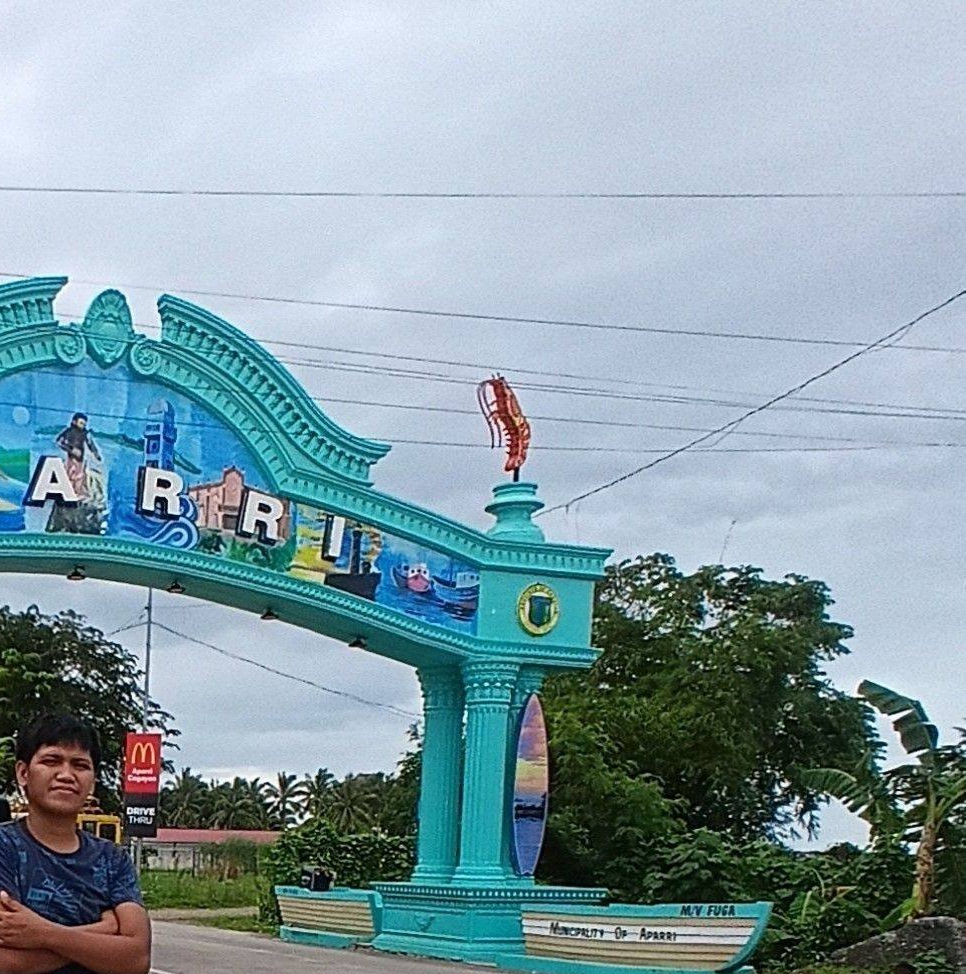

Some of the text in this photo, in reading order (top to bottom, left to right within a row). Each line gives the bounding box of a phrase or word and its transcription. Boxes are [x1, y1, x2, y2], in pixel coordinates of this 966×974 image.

[127, 807, 155, 815] DRIVE
[129, 816, 153, 824] THRU
[706, 905, 736, 916] FUGA
